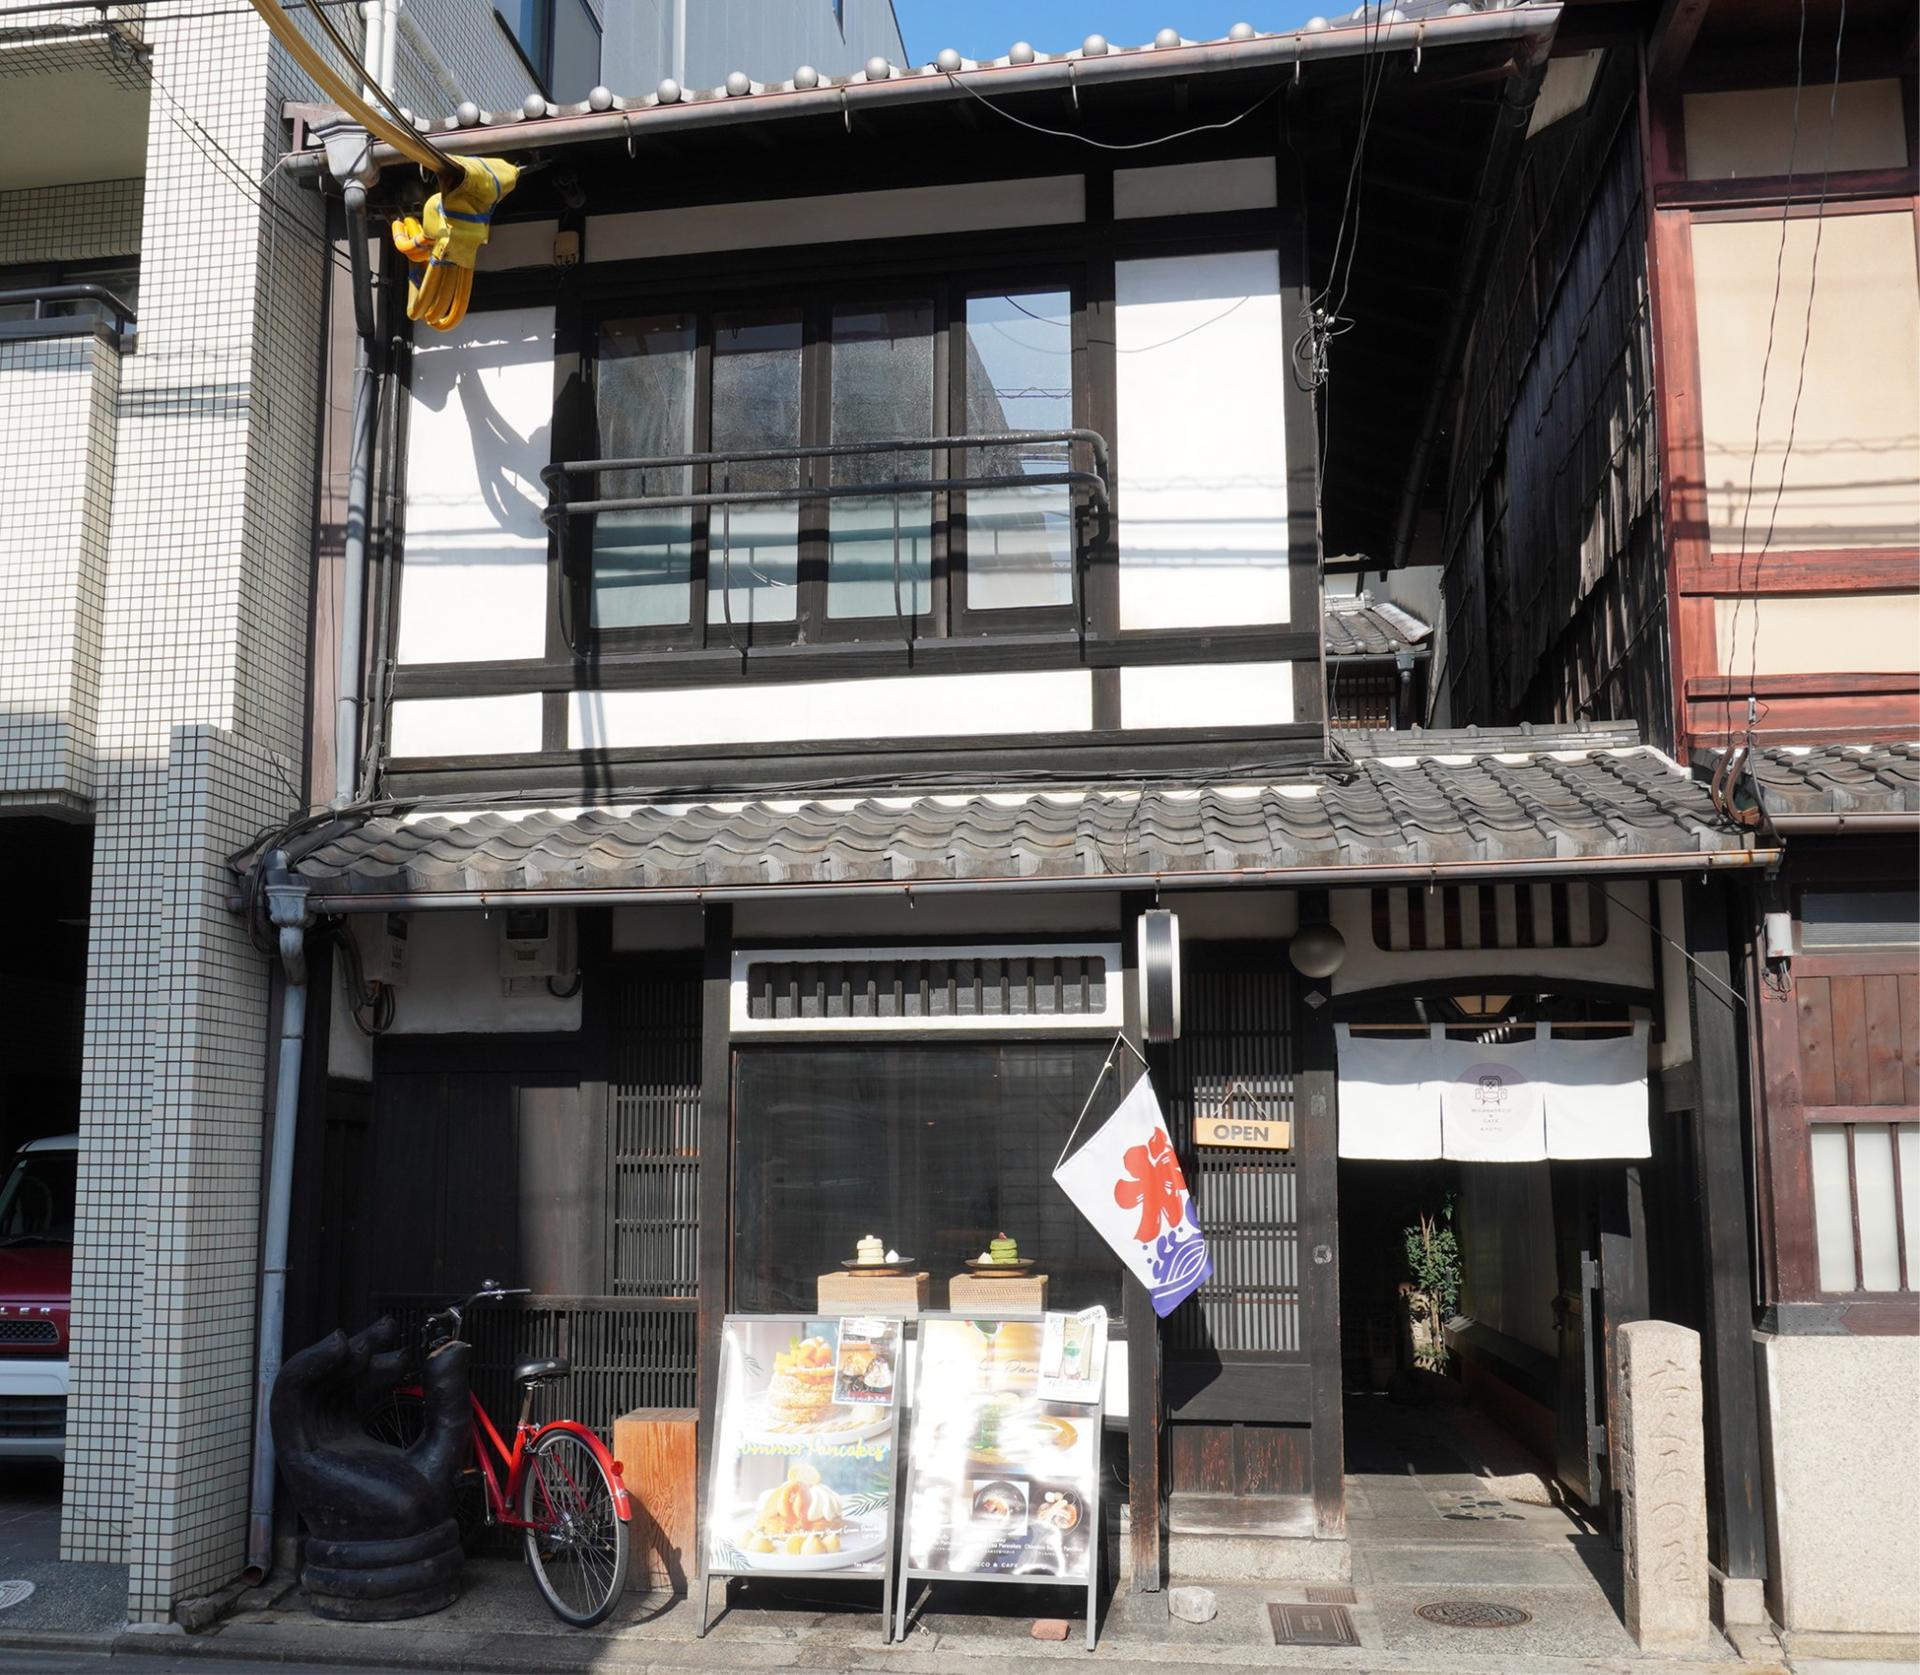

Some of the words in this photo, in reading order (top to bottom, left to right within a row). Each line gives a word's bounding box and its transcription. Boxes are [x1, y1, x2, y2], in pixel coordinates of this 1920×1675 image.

[1213, 1124, 1269, 1142] OPEN
[1113, 1126, 1189, 1243] 氷
[738, 1440, 803, 1458] ummer
